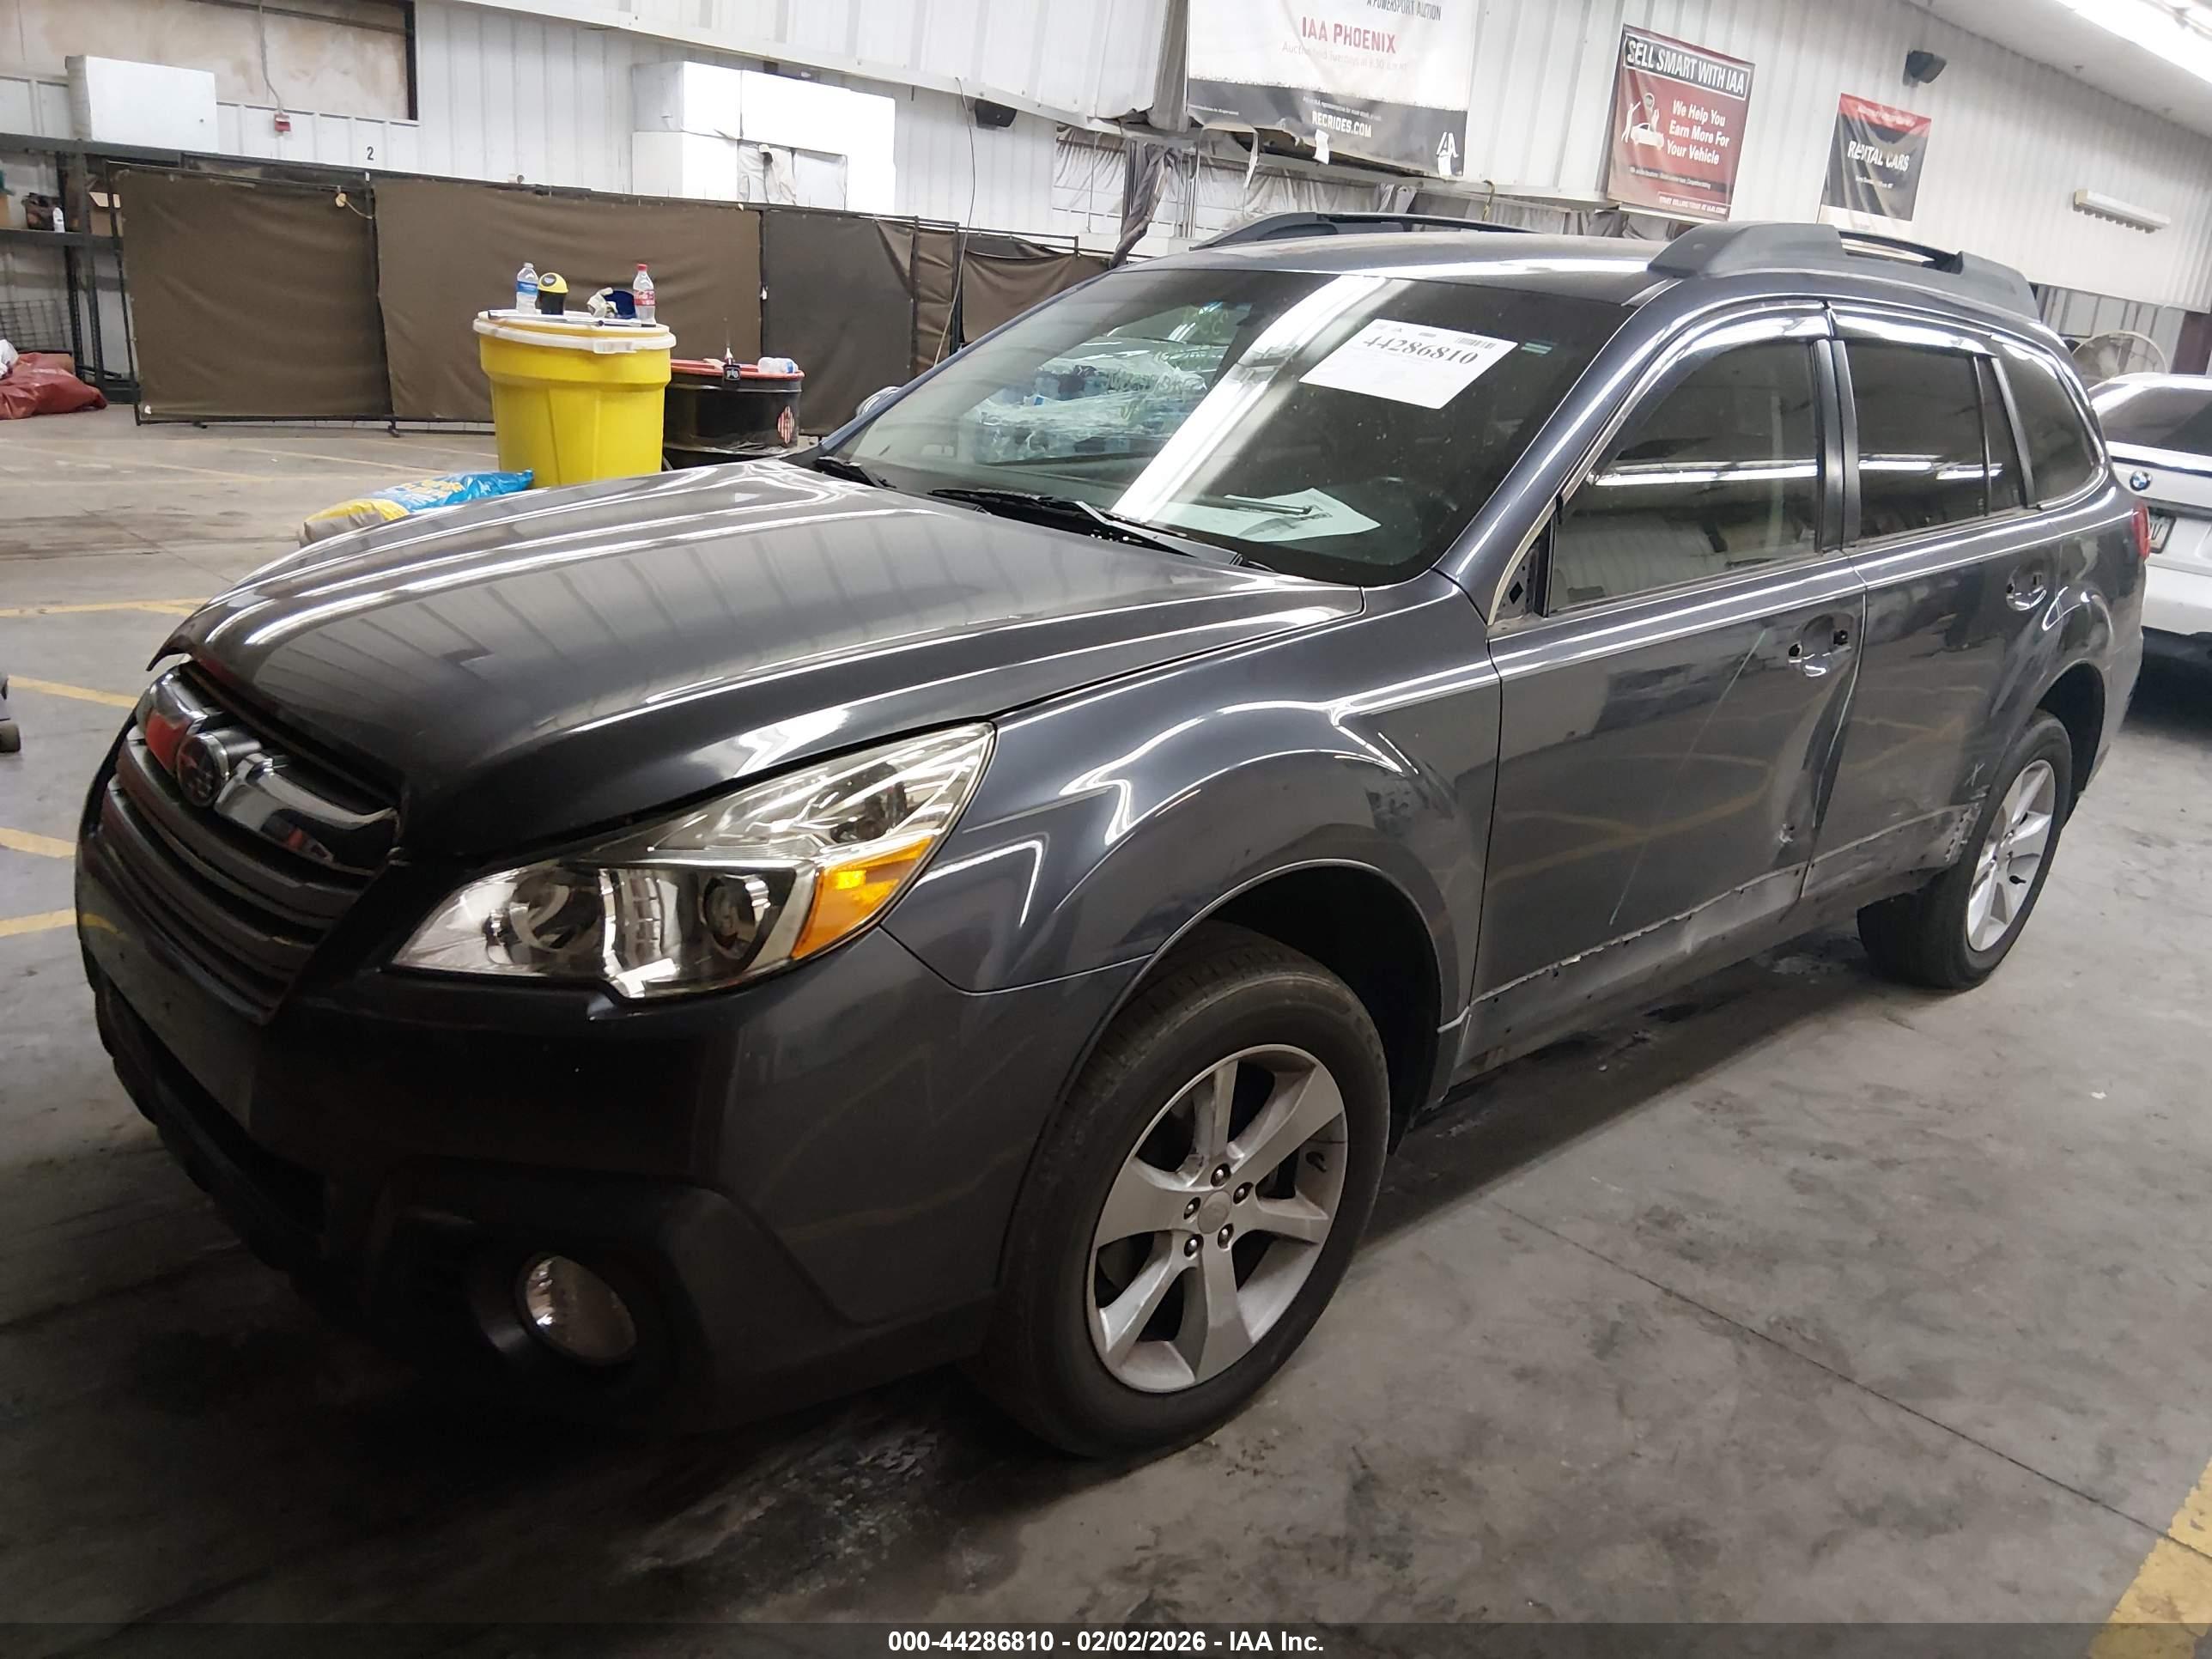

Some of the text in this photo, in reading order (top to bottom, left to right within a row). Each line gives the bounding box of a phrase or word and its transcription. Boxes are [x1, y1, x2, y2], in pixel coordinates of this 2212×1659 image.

[1302, 16, 1396, 54] IAA PHOENIX
[1626, 40, 1745, 94] SELL SMART WITH IAA
[1311, 111, 1372, 138] RECRIDES.COM
[1673, 100, 1726, 127] We Help You
[1669, 119, 1730, 148] Earn More For
[367, 146, 374, 161] 2
[1667, 138, 1720, 165] Your Vehicle
[1363, 336, 1479, 364] 44286810
